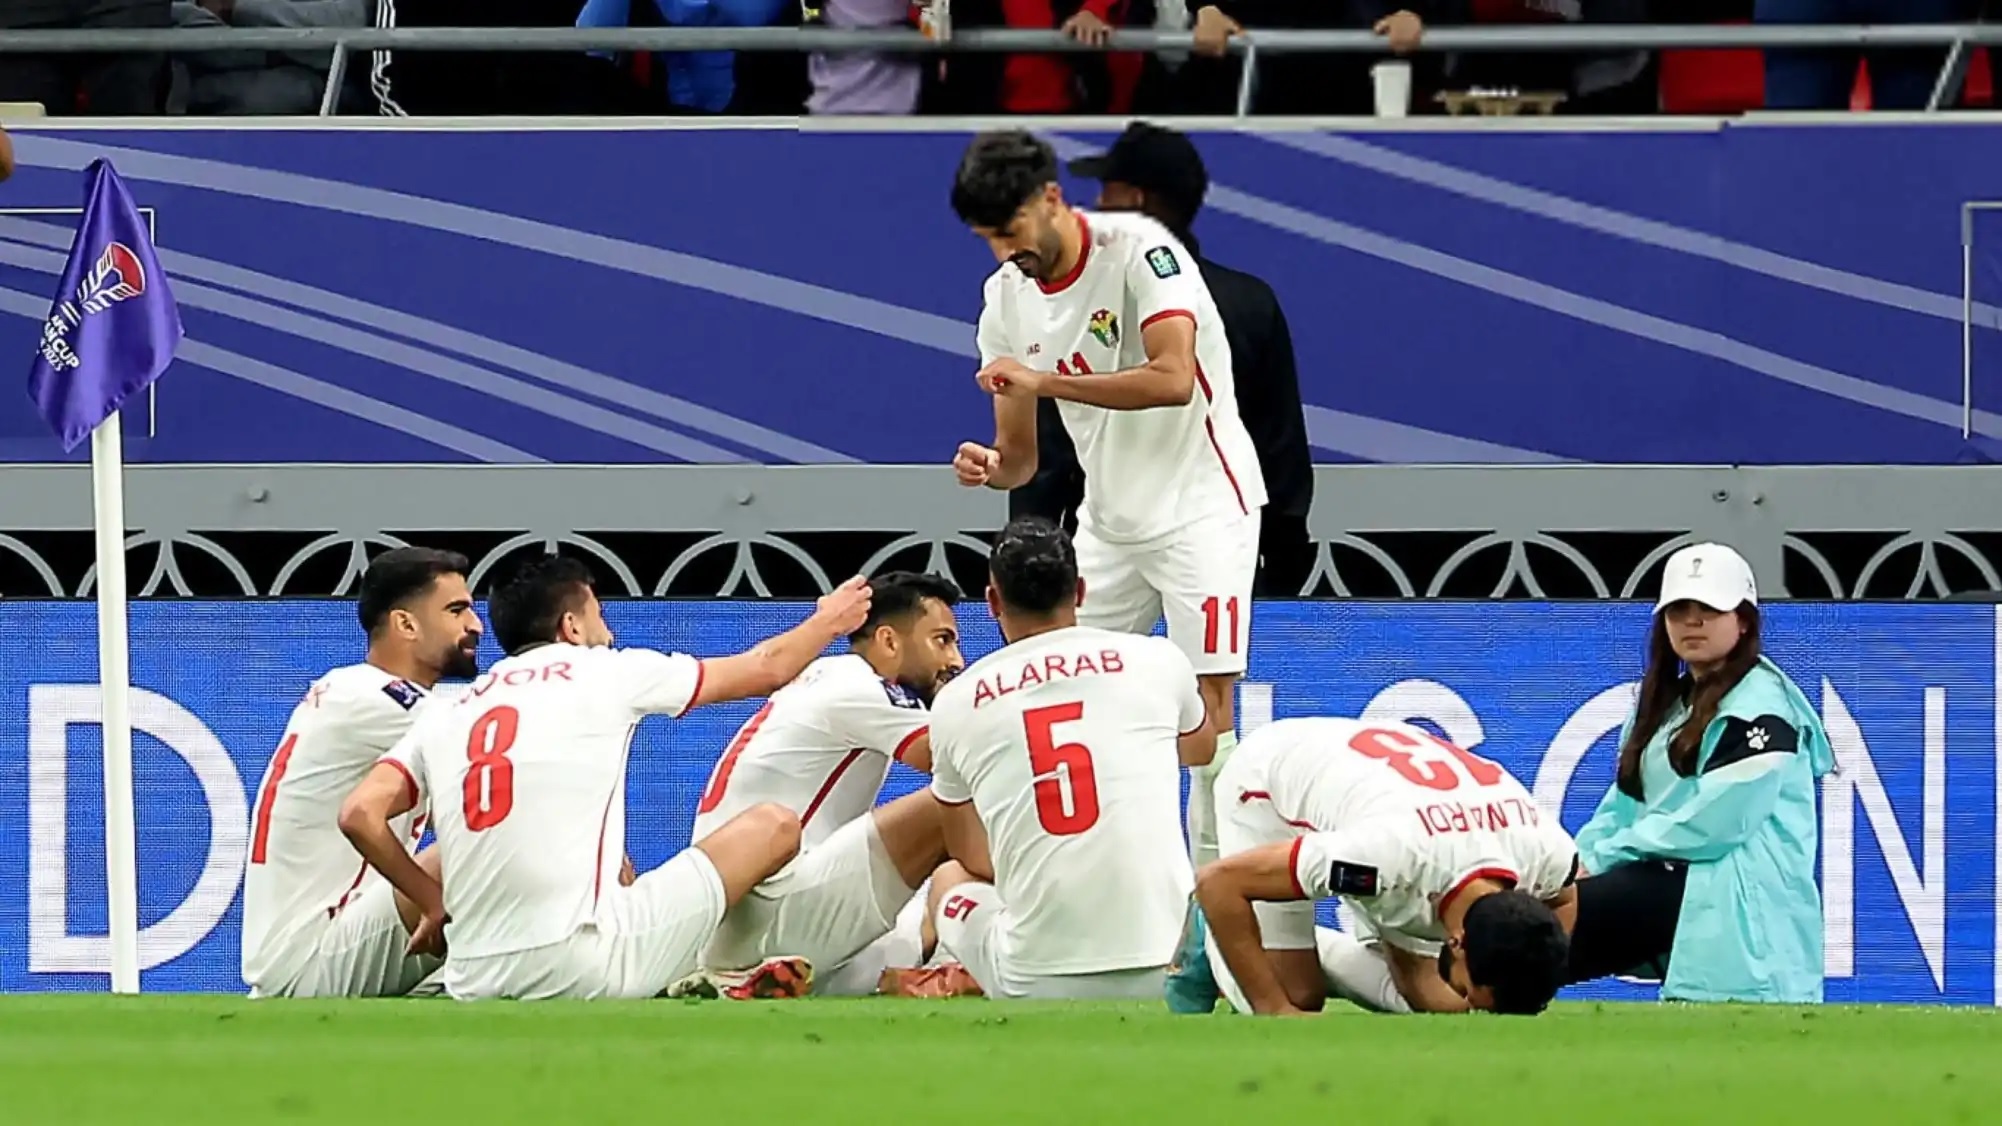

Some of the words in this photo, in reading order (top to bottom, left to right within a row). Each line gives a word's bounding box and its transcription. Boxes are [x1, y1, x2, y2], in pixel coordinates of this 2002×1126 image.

[52, 338, 79, 368] CUP
[1202, 597, 1238, 653] 11
[974, 650, 1123, 708] ALARAB
[463, 705, 519, 833] 8
[1023, 701, 1099, 836] 5
[1348, 728, 1503, 791] 13
[944, 895, 979, 921] 5
